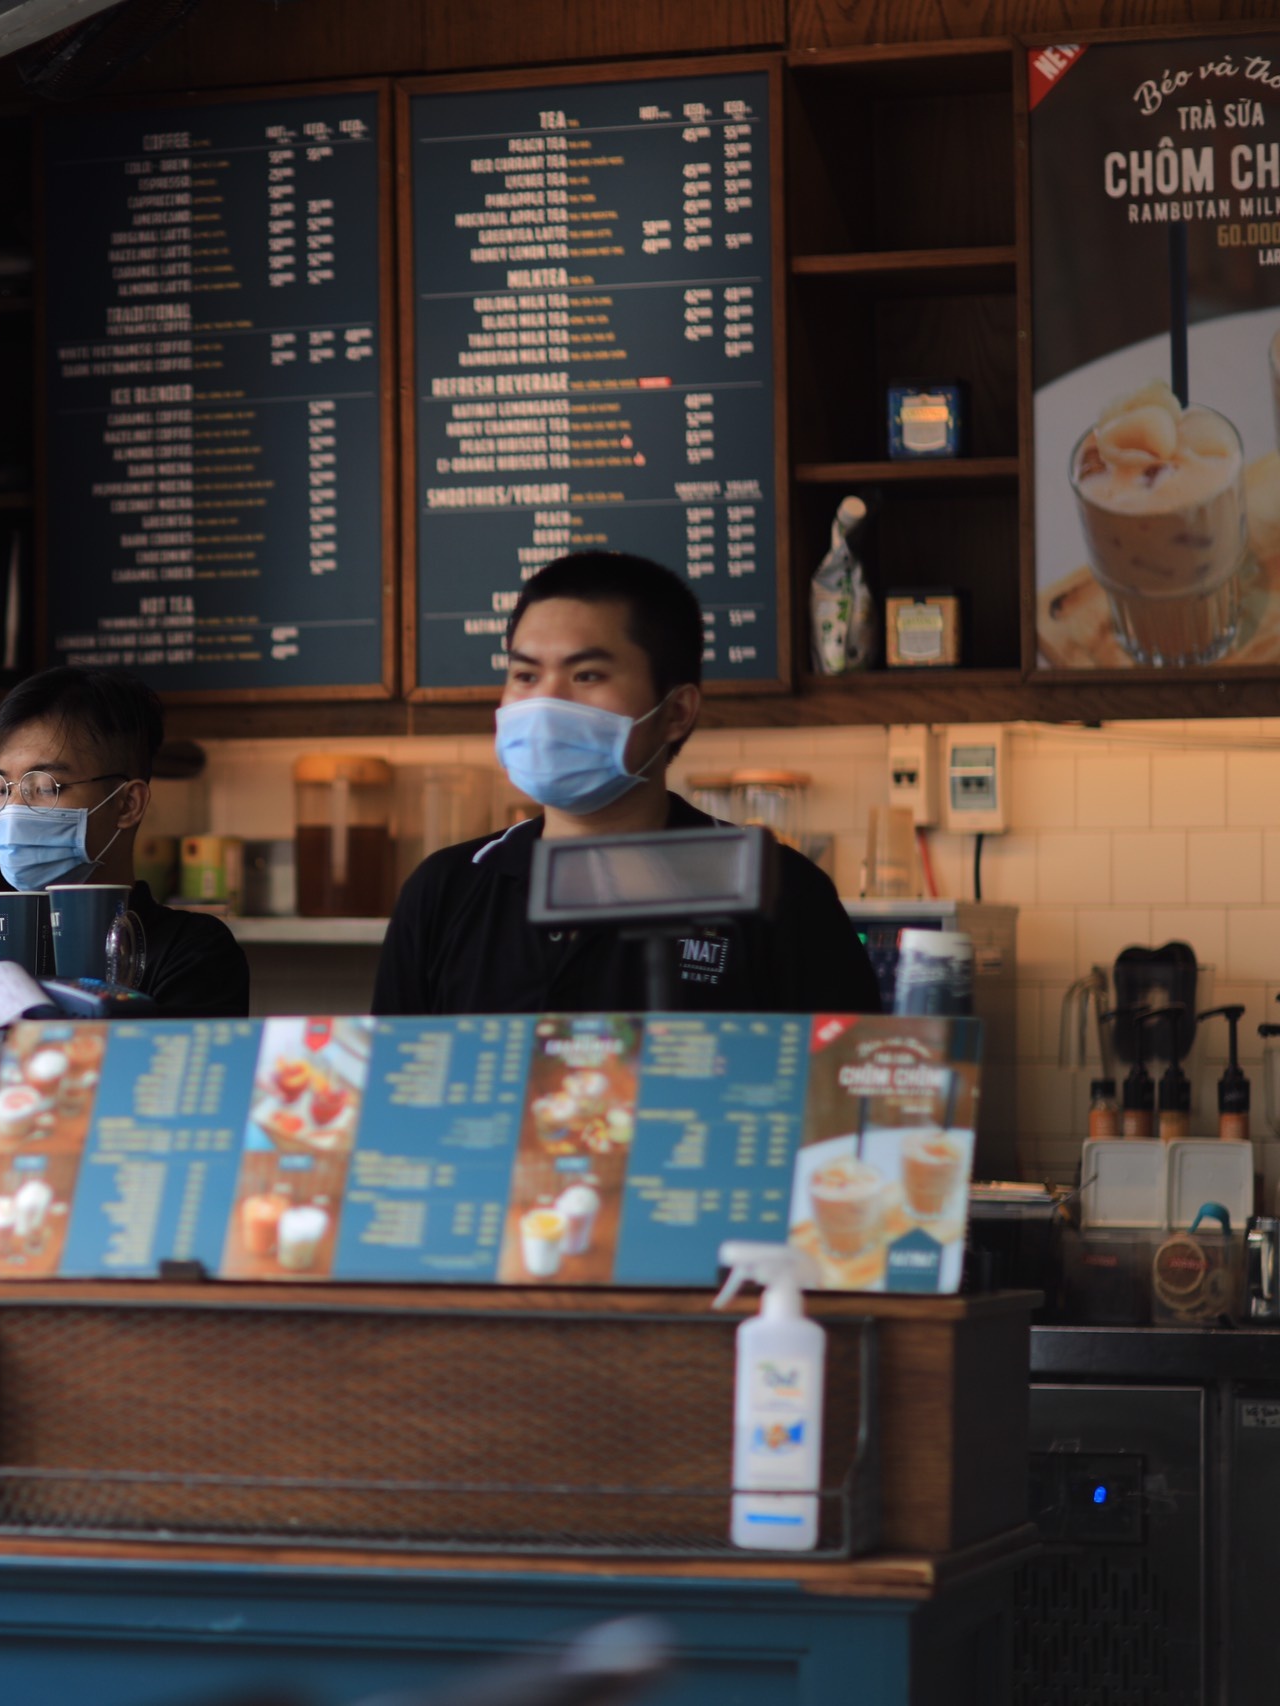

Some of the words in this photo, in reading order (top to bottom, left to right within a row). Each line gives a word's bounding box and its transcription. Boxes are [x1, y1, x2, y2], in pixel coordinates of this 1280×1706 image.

[538, 110, 566, 129] TEA
[1177, 98, 1216, 131] TRÀ
[1224, 98, 1265, 128] SỮA
[546, 135, 567, 150] TEA
[546, 153, 567, 168] TEA
[1104, 136, 1215, 198] CHÔM
[546, 171, 567, 186] TEA
[546, 189, 567, 204] TEA
[546, 206, 568, 222] TEA
[1128, 200, 1230, 224] RAMBUTAN
[547, 242, 568, 258] TEA
[547, 292, 569, 308] TEA
[548, 310, 568, 326] TEA
[547, 328, 569, 344] TEA
[548, 346, 569, 362] TEA
[431, 375, 494, 396] REFRESH
[496, 372, 567, 394] BEVERAGE
[548, 416, 569, 432] TEA
[548, 434, 569, 450] TEA
[548, 452, 570, 468] TEA
